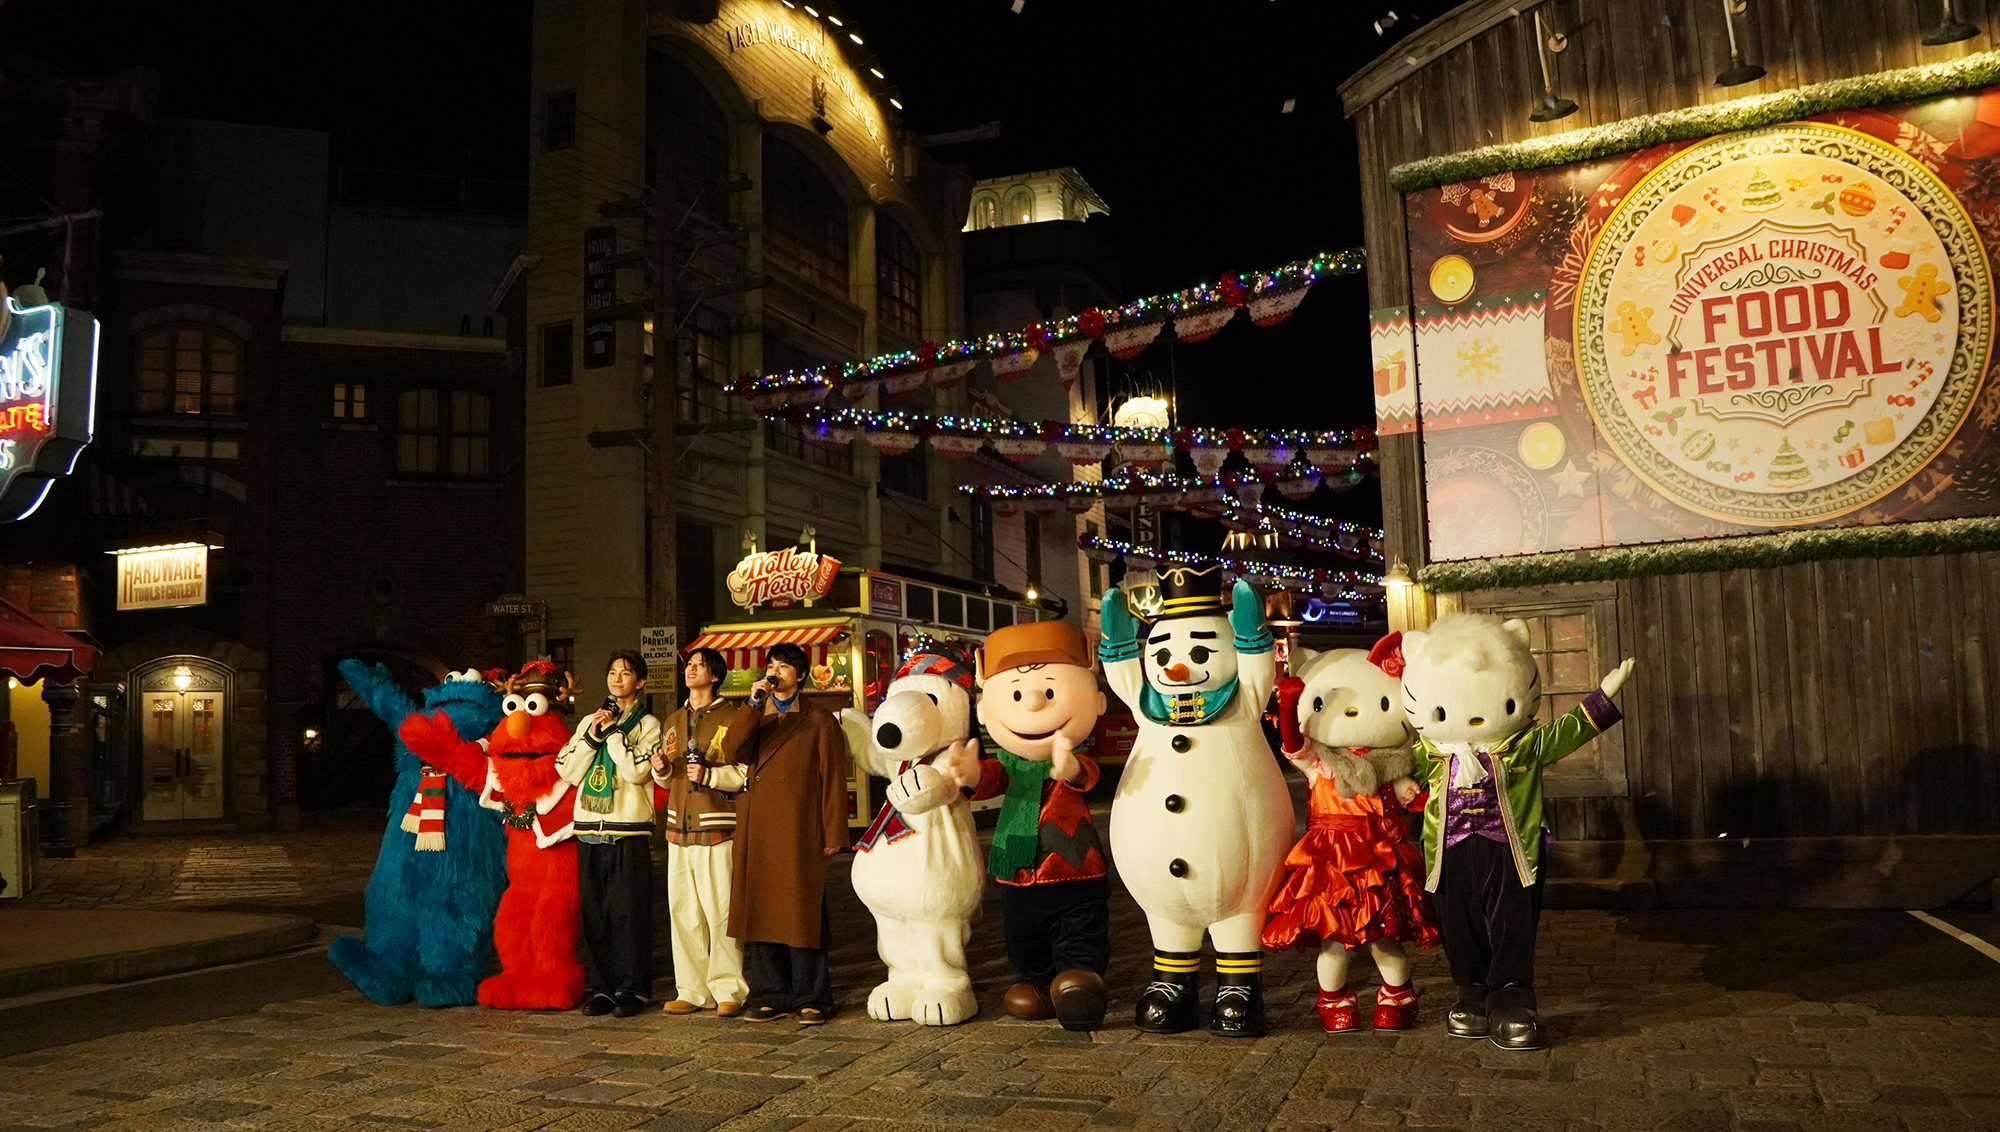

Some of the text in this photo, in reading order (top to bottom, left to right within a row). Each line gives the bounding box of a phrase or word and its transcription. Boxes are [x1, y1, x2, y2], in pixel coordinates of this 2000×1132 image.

[767, 21, 831, 76] WAREHOUSE
[832, 63, 840, 85] &
[840, 72, 881, 147] STORAGE
[1669, 239, 1878, 316] UNIVERSAL CHRISTMAS
[1701, 280, 1851, 344] FOOD
[1666, 327, 1902, 398] FESTIVAL
[123, 552, 203, 604] HARDWARE
[737, 550, 817, 581] Trolley
[133, 585, 161, 602] TOOLS
[165, 582, 203, 600] CUTLERY
[728, 572, 811, 608] Treats
[493, 604, 534, 614] WATER ST.
[642, 633, 675, 646] PARKING
[652, 629, 665, 637] NO
[643, 651, 673, 659] BLOCK
